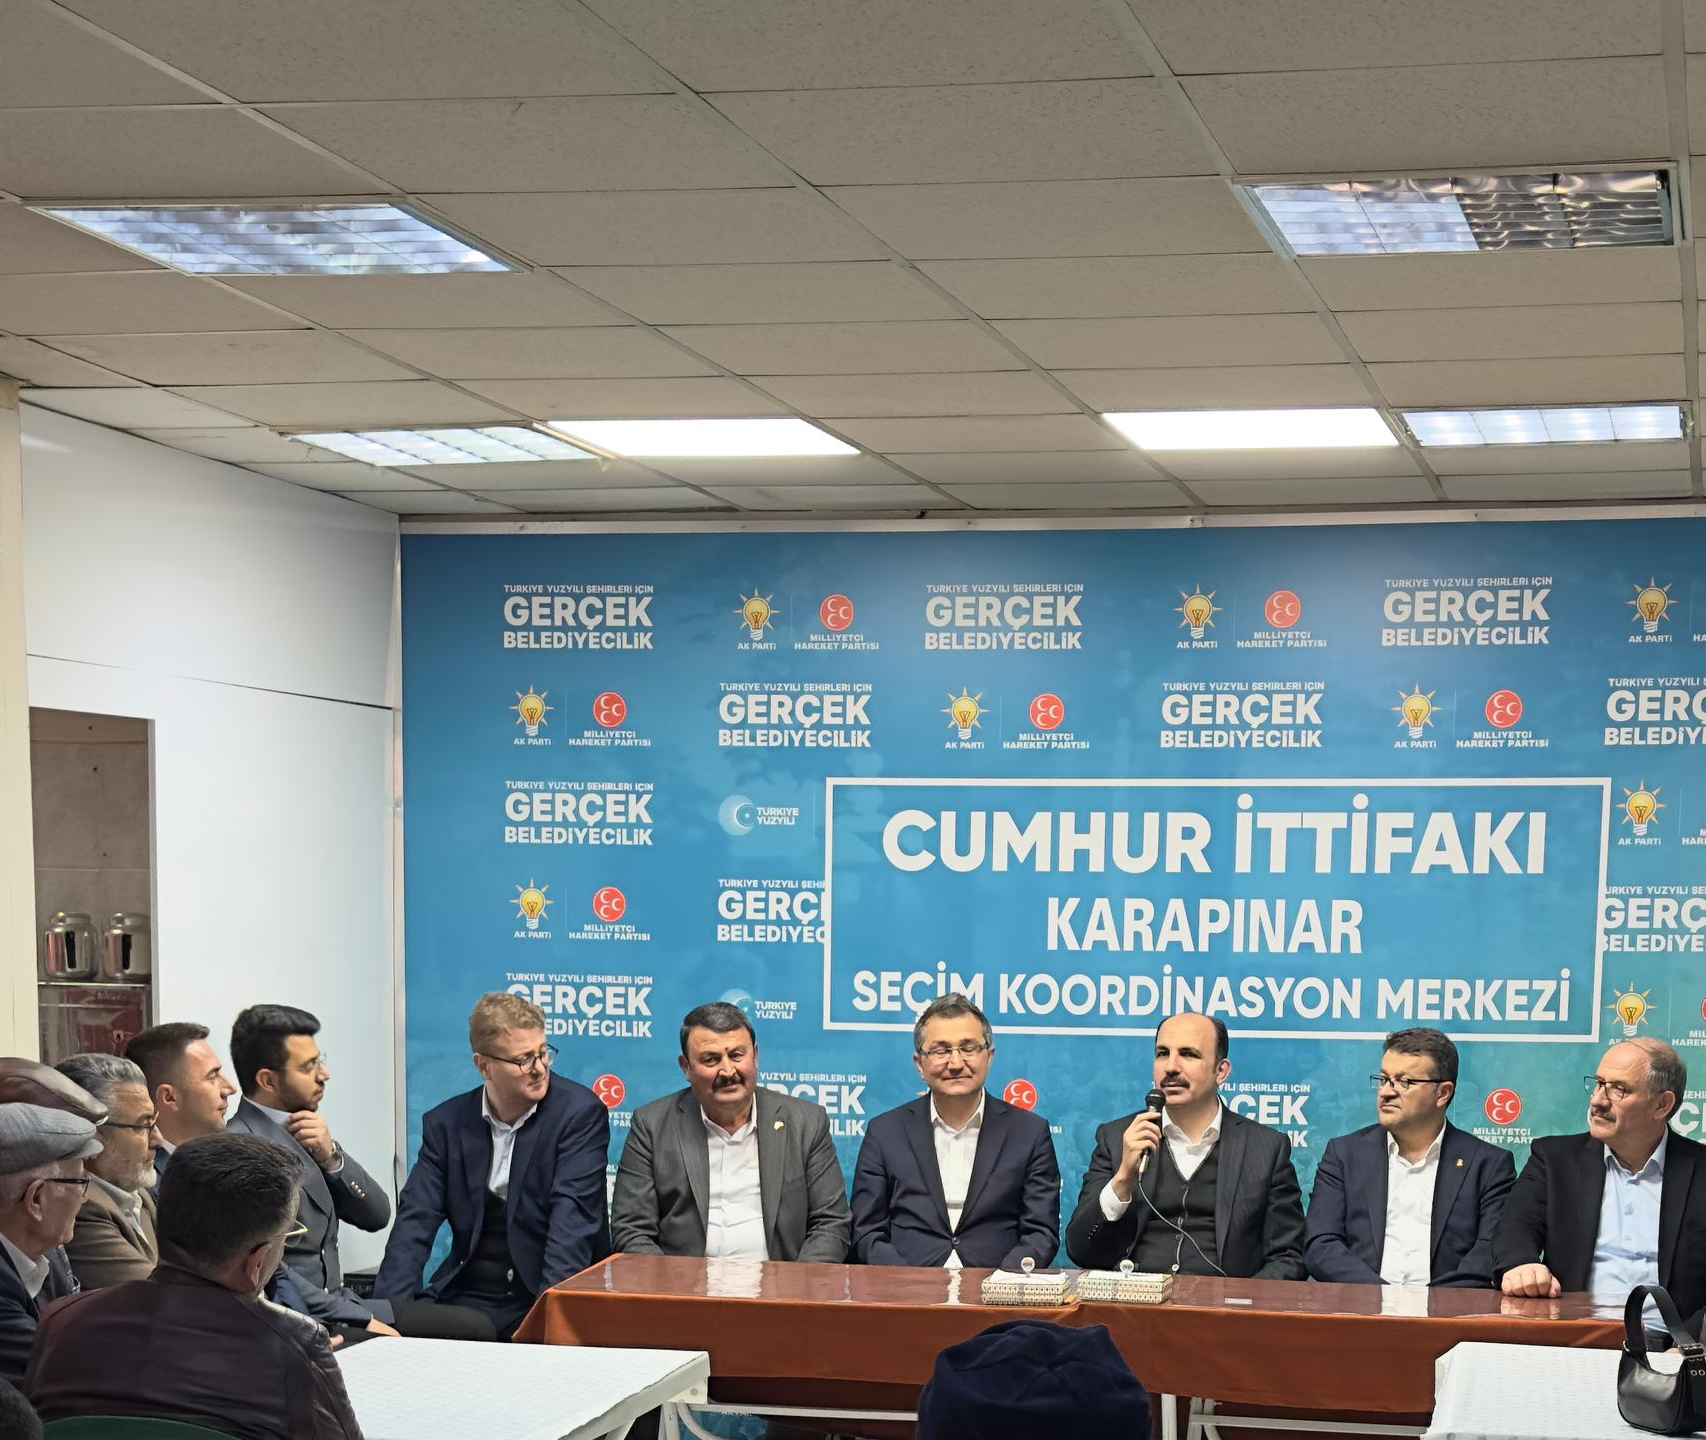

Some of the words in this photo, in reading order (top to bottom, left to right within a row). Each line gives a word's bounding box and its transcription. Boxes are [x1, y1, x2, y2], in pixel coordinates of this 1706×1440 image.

[504, 596, 653, 630] GERÇEK
[926, 596, 1082, 631] GERÇEK
[1384, 589, 1550, 625] GERÇEK
[720, 694, 870, 728] GERÇEK
[1162, 694, 1323, 729] GERÇEK
[1457, 739, 1504, 747] HAREKET
[506, 793, 652, 826] GERÇEK
[883, 810, 1211, 873] CUMHUR
[1235, 793, 1546, 874] İTTİFAKI
[718, 890, 825, 924] GERÇ
[1048, 897, 1362, 953] KARAPINAR
[853, 961, 983, 1020] SEÇİM
[1000, 964, 1361, 1018] KOORDİNASYON
[1377, 968, 1569, 1021] MERKEZİ
